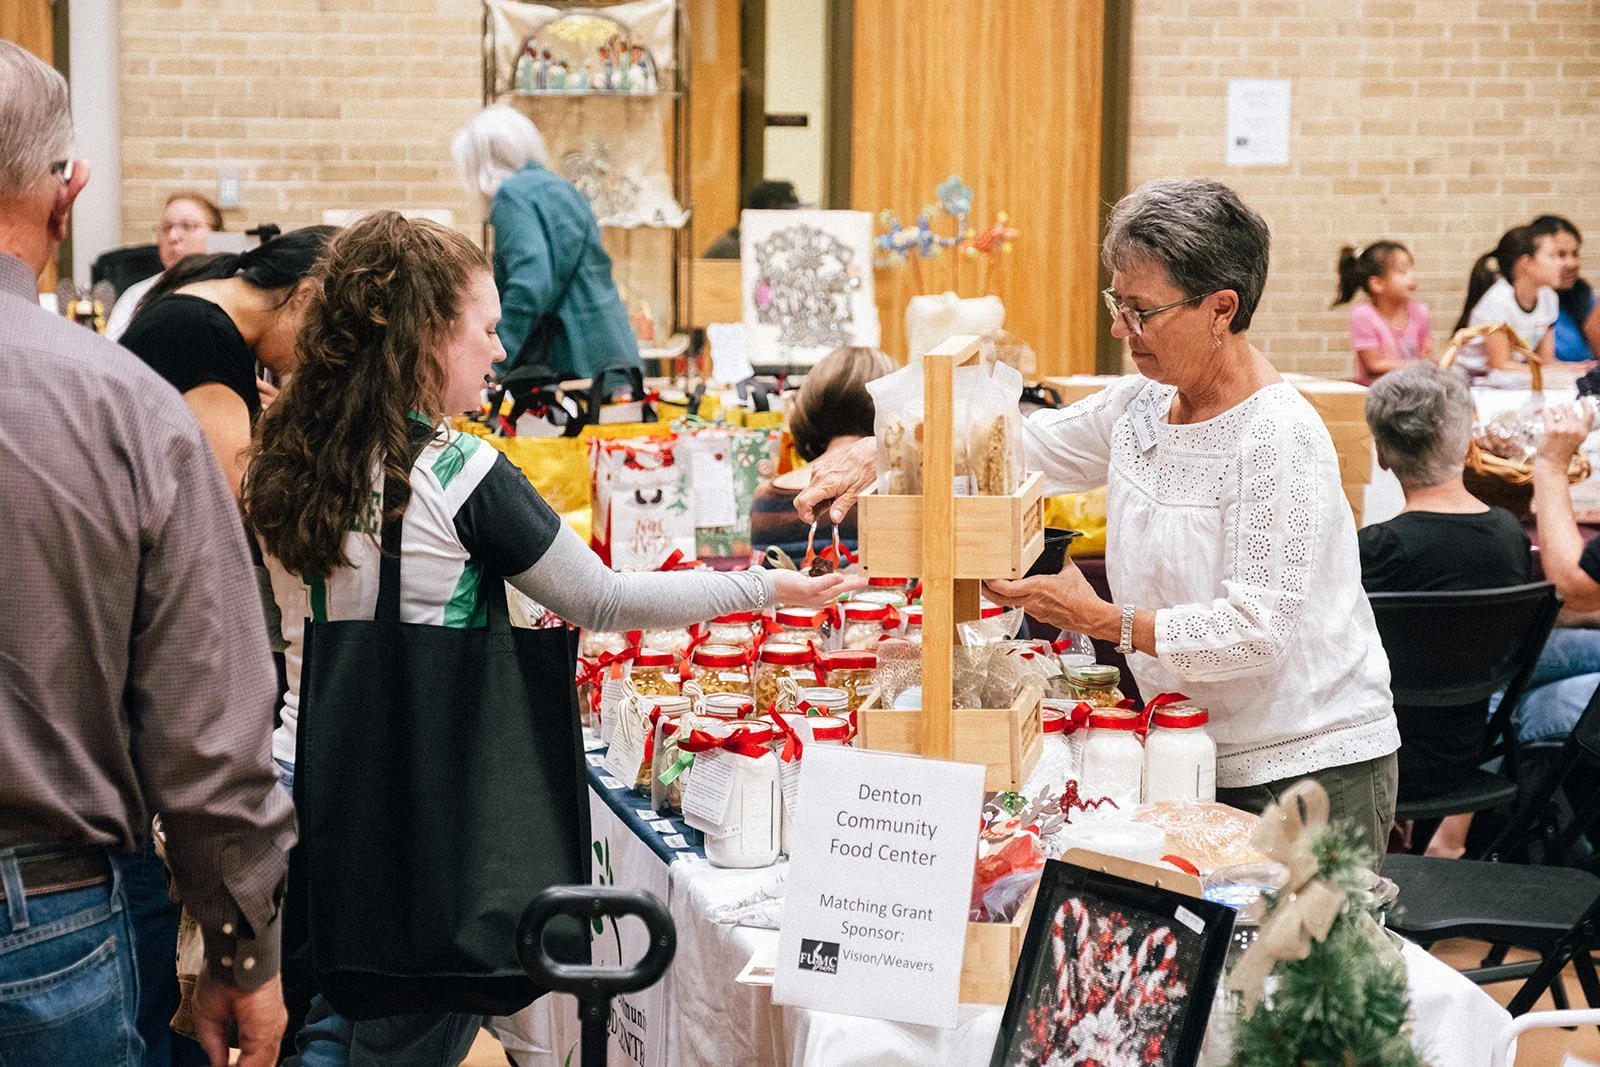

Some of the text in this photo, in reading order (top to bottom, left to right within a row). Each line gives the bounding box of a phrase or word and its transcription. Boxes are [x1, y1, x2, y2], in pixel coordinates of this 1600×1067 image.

[1144, 412, 1157, 442] Wanda
[858, 784, 922, 806] Denton
[836, 811, 938, 841] Community
[830, 838, 937, 866] Food Center
[819, 893, 933, 922] Matching Grant
[841, 921, 904, 942] Sponsor:
[842, 949, 934, 972] Vision/Weavers
